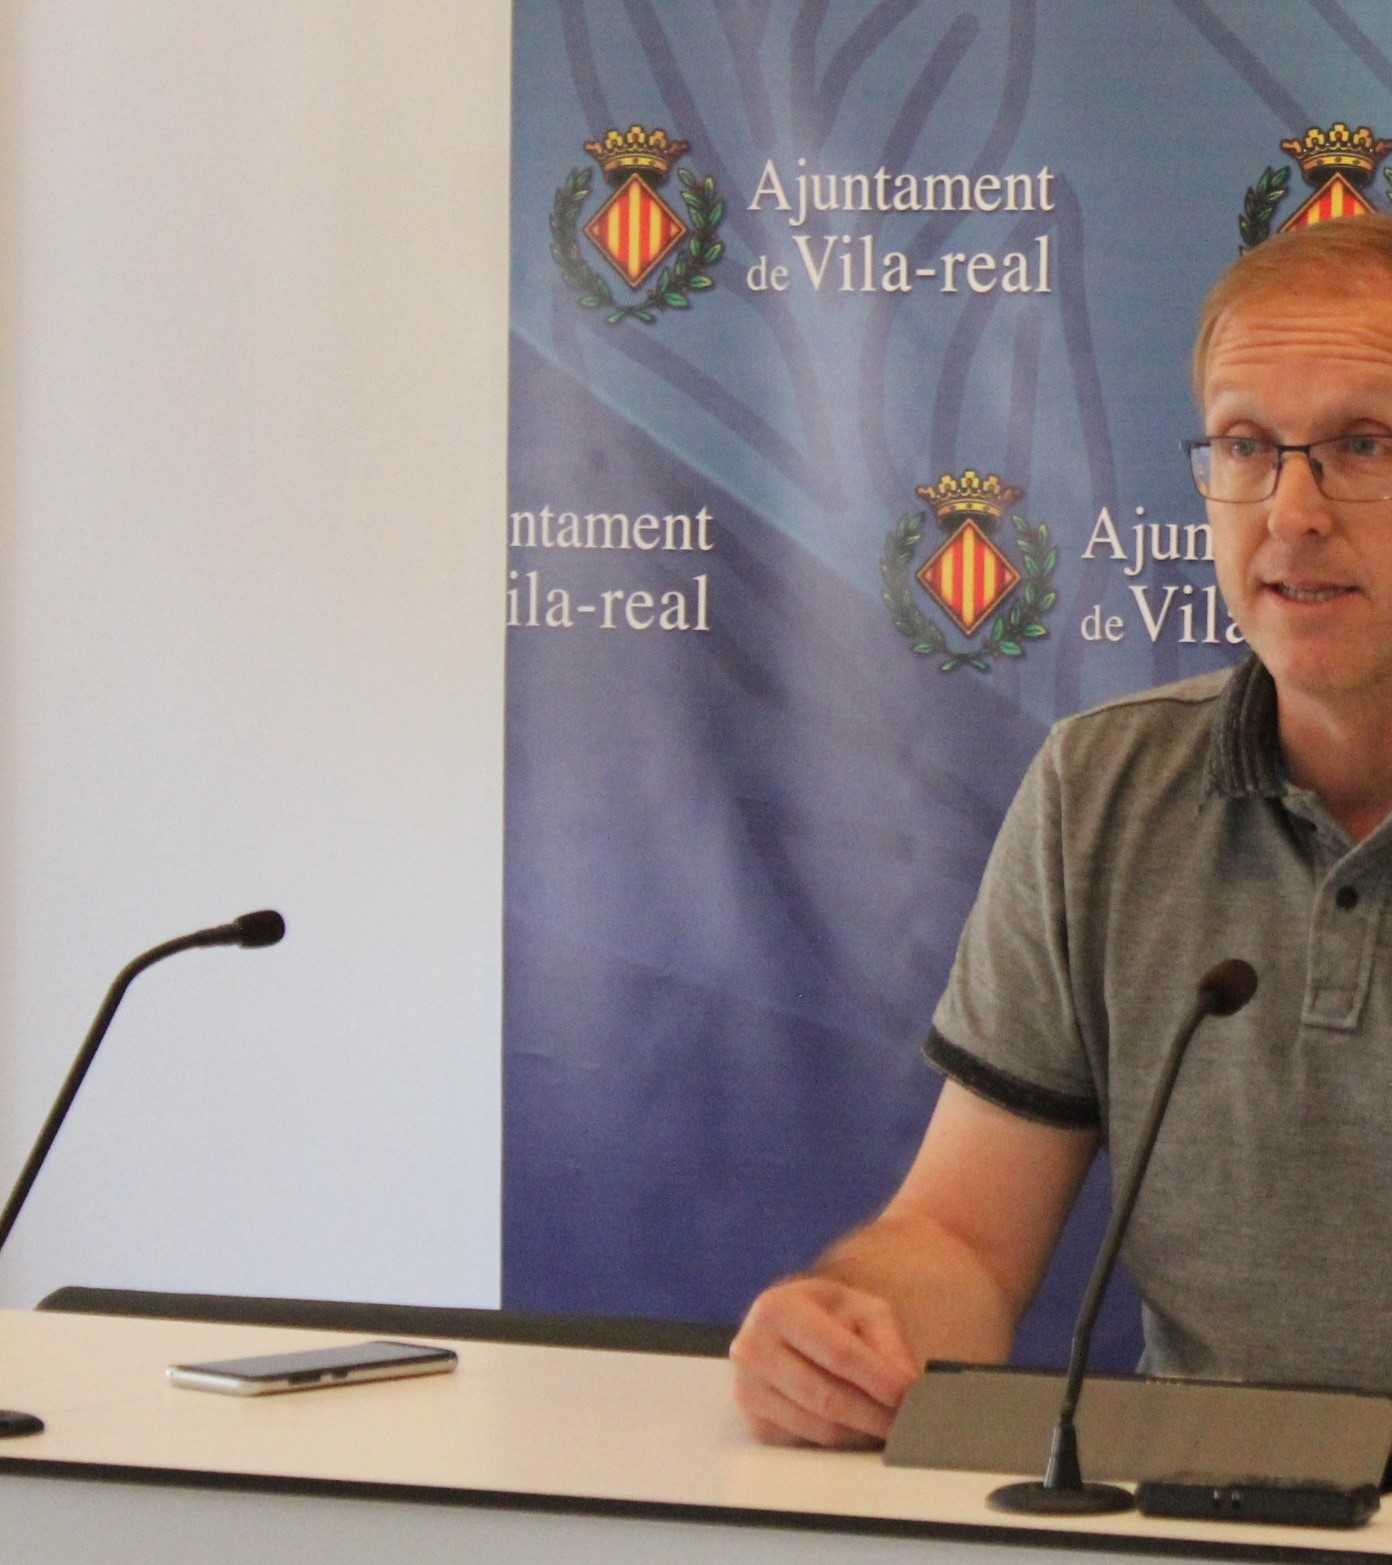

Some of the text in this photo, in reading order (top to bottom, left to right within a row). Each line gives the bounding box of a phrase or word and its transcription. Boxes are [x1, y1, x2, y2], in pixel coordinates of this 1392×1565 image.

[746, 157, 1055, 226] Ajuntament
[746, 234, 1052, 293] de Vila-real
[509, 506, 714, 551] ntament
[1080, 604, 1125, 642] de
